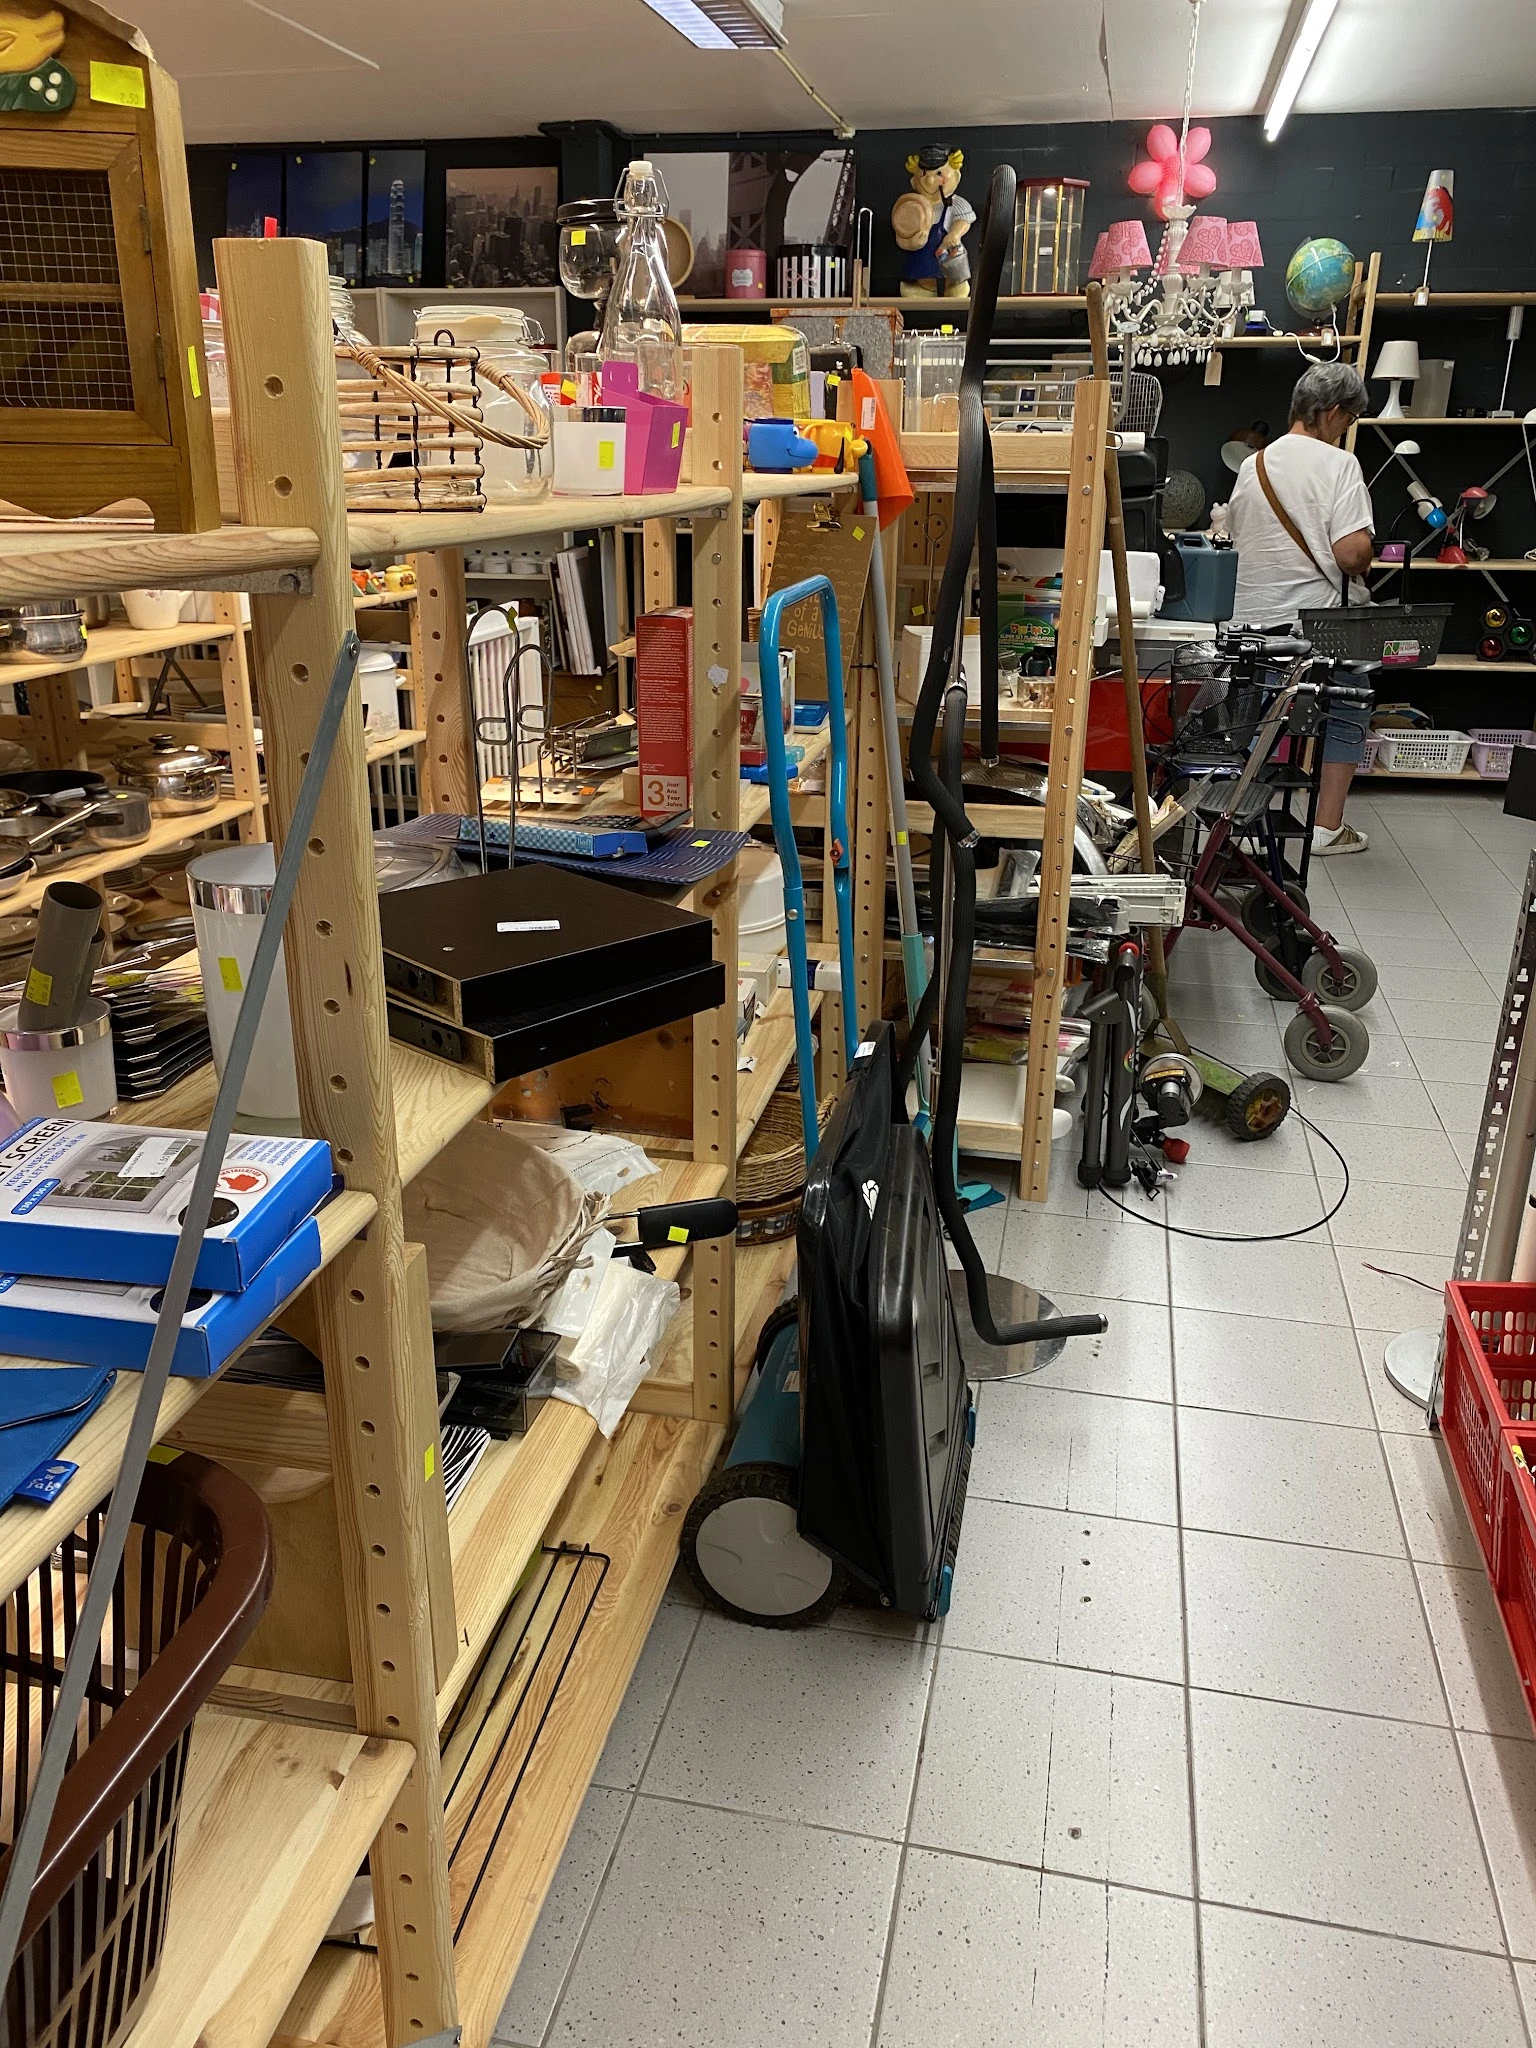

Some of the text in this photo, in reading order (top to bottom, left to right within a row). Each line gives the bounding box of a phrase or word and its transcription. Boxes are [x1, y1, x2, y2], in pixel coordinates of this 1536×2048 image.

[794, 603, 819, 621] of a
[647, 780, 665, 806] 3
[5, 1119, 76, 1161] SCREEN
[4, 1136, 70, 1187] KEEPS INSECTS OUT
[13, 1133, 88, 1193] AND LETS FRESH AIR IN
[18, 1200, 33, 1211] 130
[32, 1186, 48, 1198] 150
